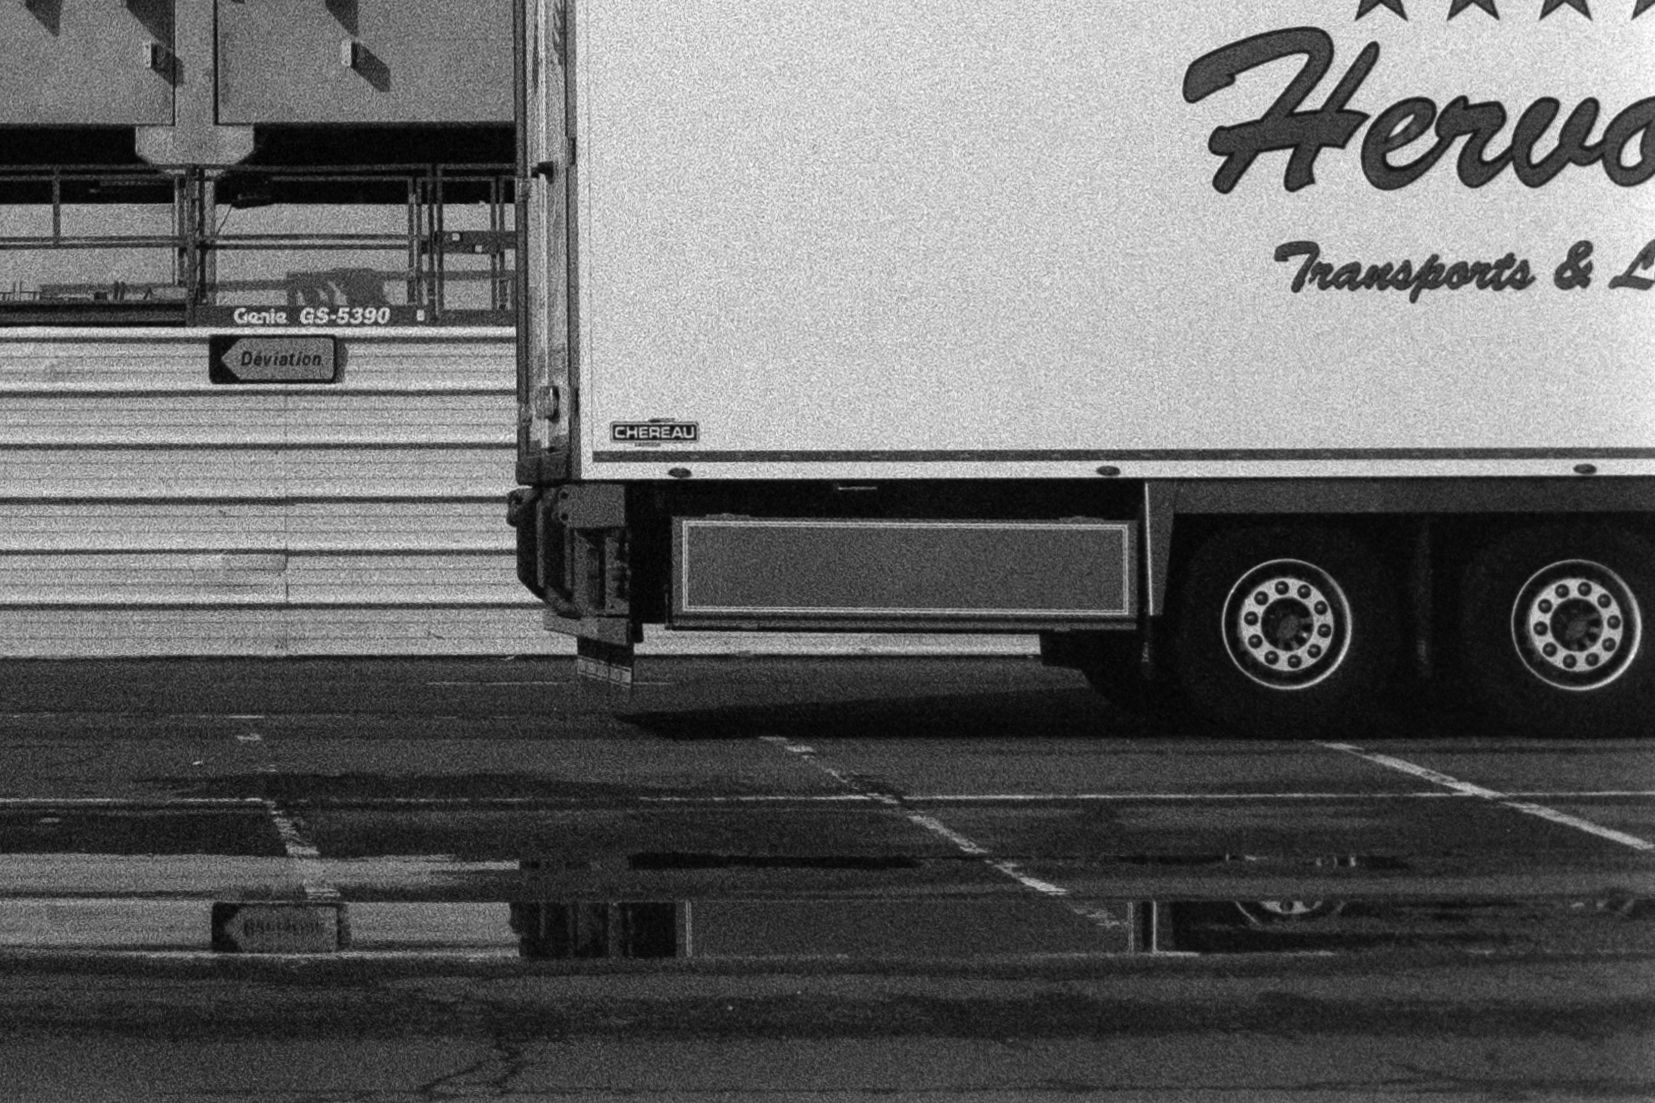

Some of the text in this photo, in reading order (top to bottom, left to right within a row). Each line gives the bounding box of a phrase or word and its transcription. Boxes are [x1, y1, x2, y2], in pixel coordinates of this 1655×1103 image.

[1274, 240, 1536, 304] Transports
[1554, 240, 1593, 290] &
[233, 307, 391, 325] Genie GS-5390
[241, 350, 322, 367] Déviation
[614, 426, 695, 439] CHEREAU
